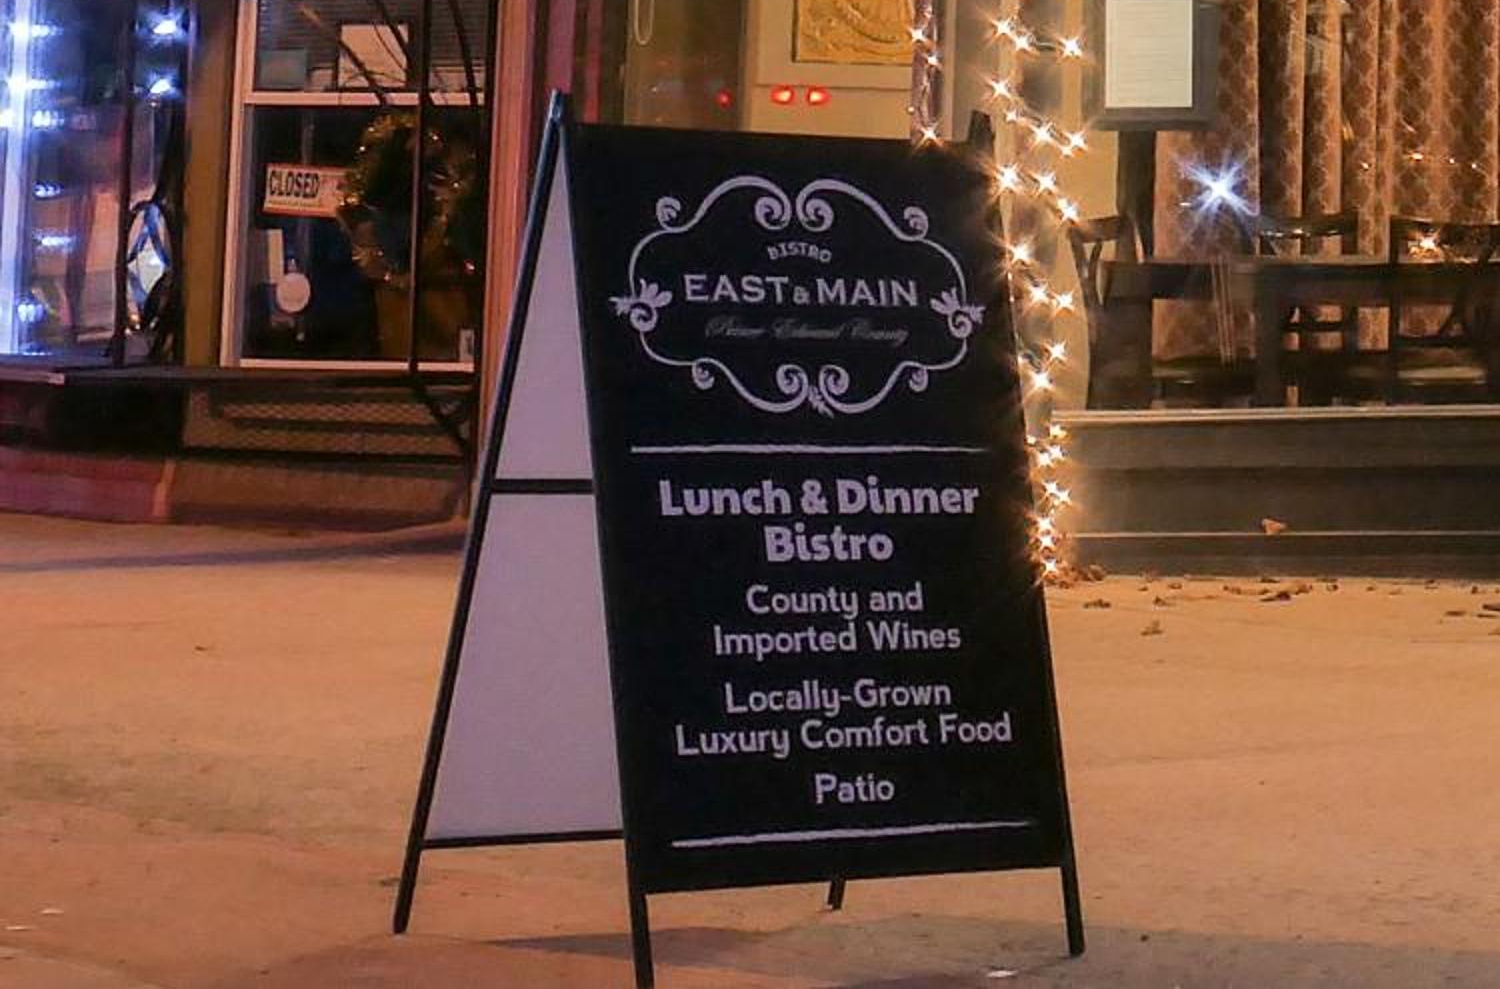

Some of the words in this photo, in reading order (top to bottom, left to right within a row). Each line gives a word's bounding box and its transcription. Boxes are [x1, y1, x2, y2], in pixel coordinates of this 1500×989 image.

[269, 170, 320, 198] CLOSED
[767, 242, 832, 263] BISTRO
[683, 274, 789, 305] EAST
[793, 286, 810, 305] &
[815, 278, 918, 307] MAIN
[659, 479, 792, 516] Lunch
[800, 479, 829, 515] &
[836, 475, 980, 514] Dinner
[764, 522, 894, 563] Bistro
[746, 584, 859, 619] County
[869, 581, 924, 612] and
[713, 624, 857, 662] Imported
[866, 620, 961, 651] Wines
[724, 678, 951, 717] Locally-Grown
[675, 724, 790, 759] Luxury
[800, 717, 930, 750] Comfort
[939, 712, 1013, 743] Food
[814, 773, 895, 804] Patio
